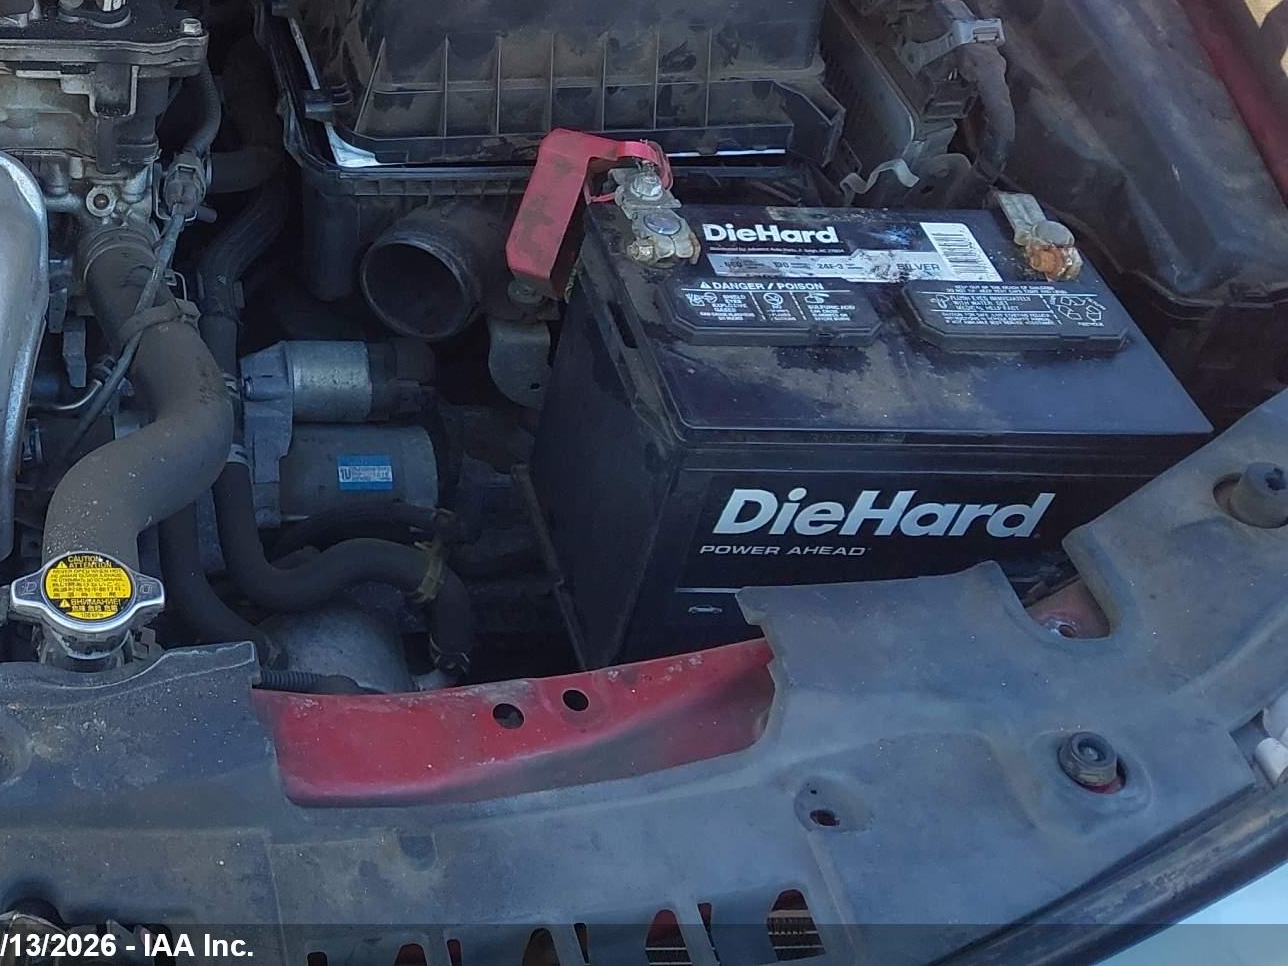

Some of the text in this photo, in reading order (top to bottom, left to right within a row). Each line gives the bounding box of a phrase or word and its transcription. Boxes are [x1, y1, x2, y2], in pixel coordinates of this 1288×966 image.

[701, 223, 839, 244] DieHard
[896, 262, 942, 272] SILVER
[712, 282, 764, 290] DANGER
[712, 487, 1056, 537] DieHard
[699, 545, 867, 556] POWER AHEAD
[67, 555, 102, 563] CAUTION
